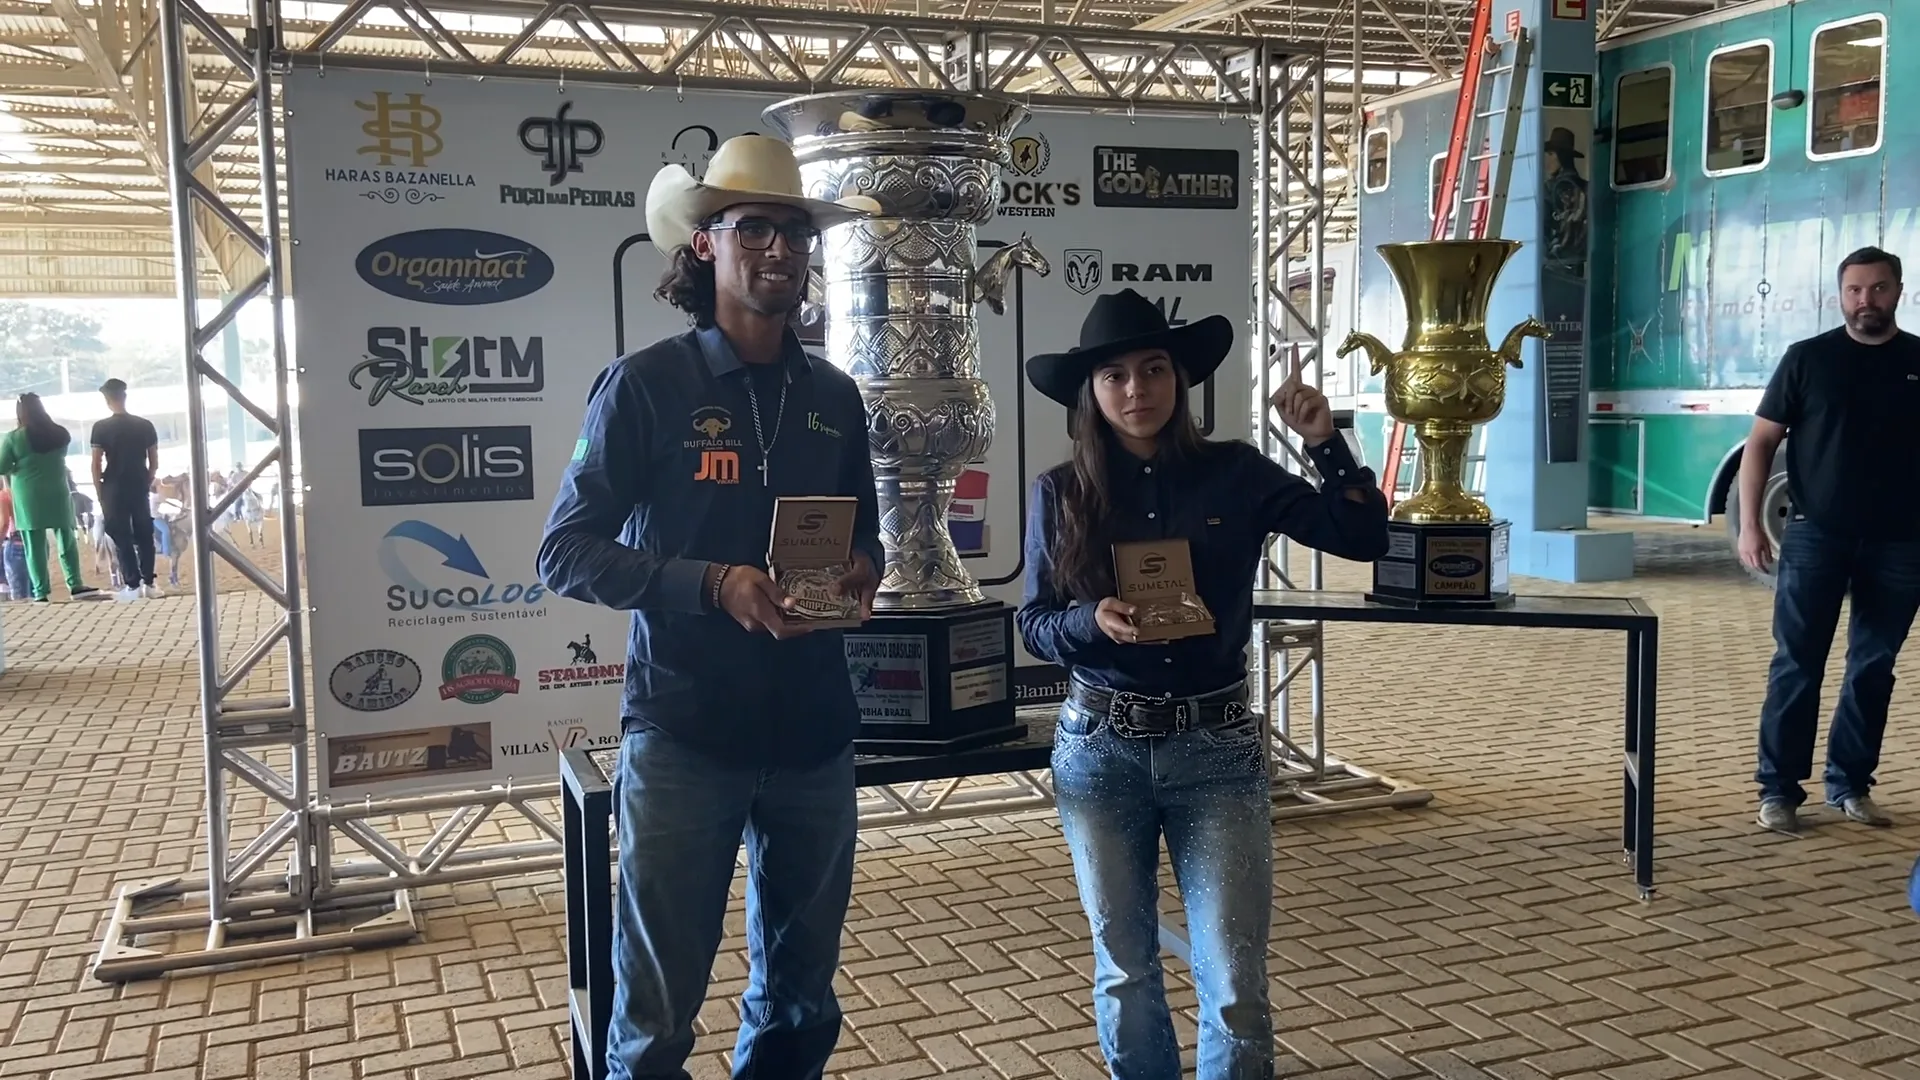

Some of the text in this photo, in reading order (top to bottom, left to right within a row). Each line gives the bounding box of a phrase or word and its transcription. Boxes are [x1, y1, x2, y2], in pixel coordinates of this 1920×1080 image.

[661, 152, 709, 161] RAN
[1099, 149, 1137, 171] THE
[325, 168, 476, 187] HARAS BAZANELLA
[500, 184, 545, 206] POÇO
[569, 186, 636, 208] PEDRAS
[997, 206, 1055, 217] WESTERN
[371, 250, 528, 291] Organnact
[1112, 264, 1212, 282] RAM
[349, 355, 468, 407] Ranch
[807, 411, 819, 430] 16
[683, 440, 723, 448] BUFFALO
[725, 439, 743, 447] BILL
[373, 434, 525, 484] solis
[694, 451, 739, 481] JM
[780, 537, 841, 546] SUMETAL
[1127, 579, 1187, 593] SUMETAL
[1434, 579, 1477, 590] CAMPEÃO
[388, 607, 548, 628] Reciclagem Sustentável
[847, 641, 922, 659] CAMPEONATO BRASILEIRO
[1015, 681, 1069, 699] GlamH
[860, 707, 912, 717] NBHA BRAZIL
[547, 718, 583, 728] RANCHO
[501, 742, 549, 757] VILLAS
[334, 746, 428, 775] BAUTZ
